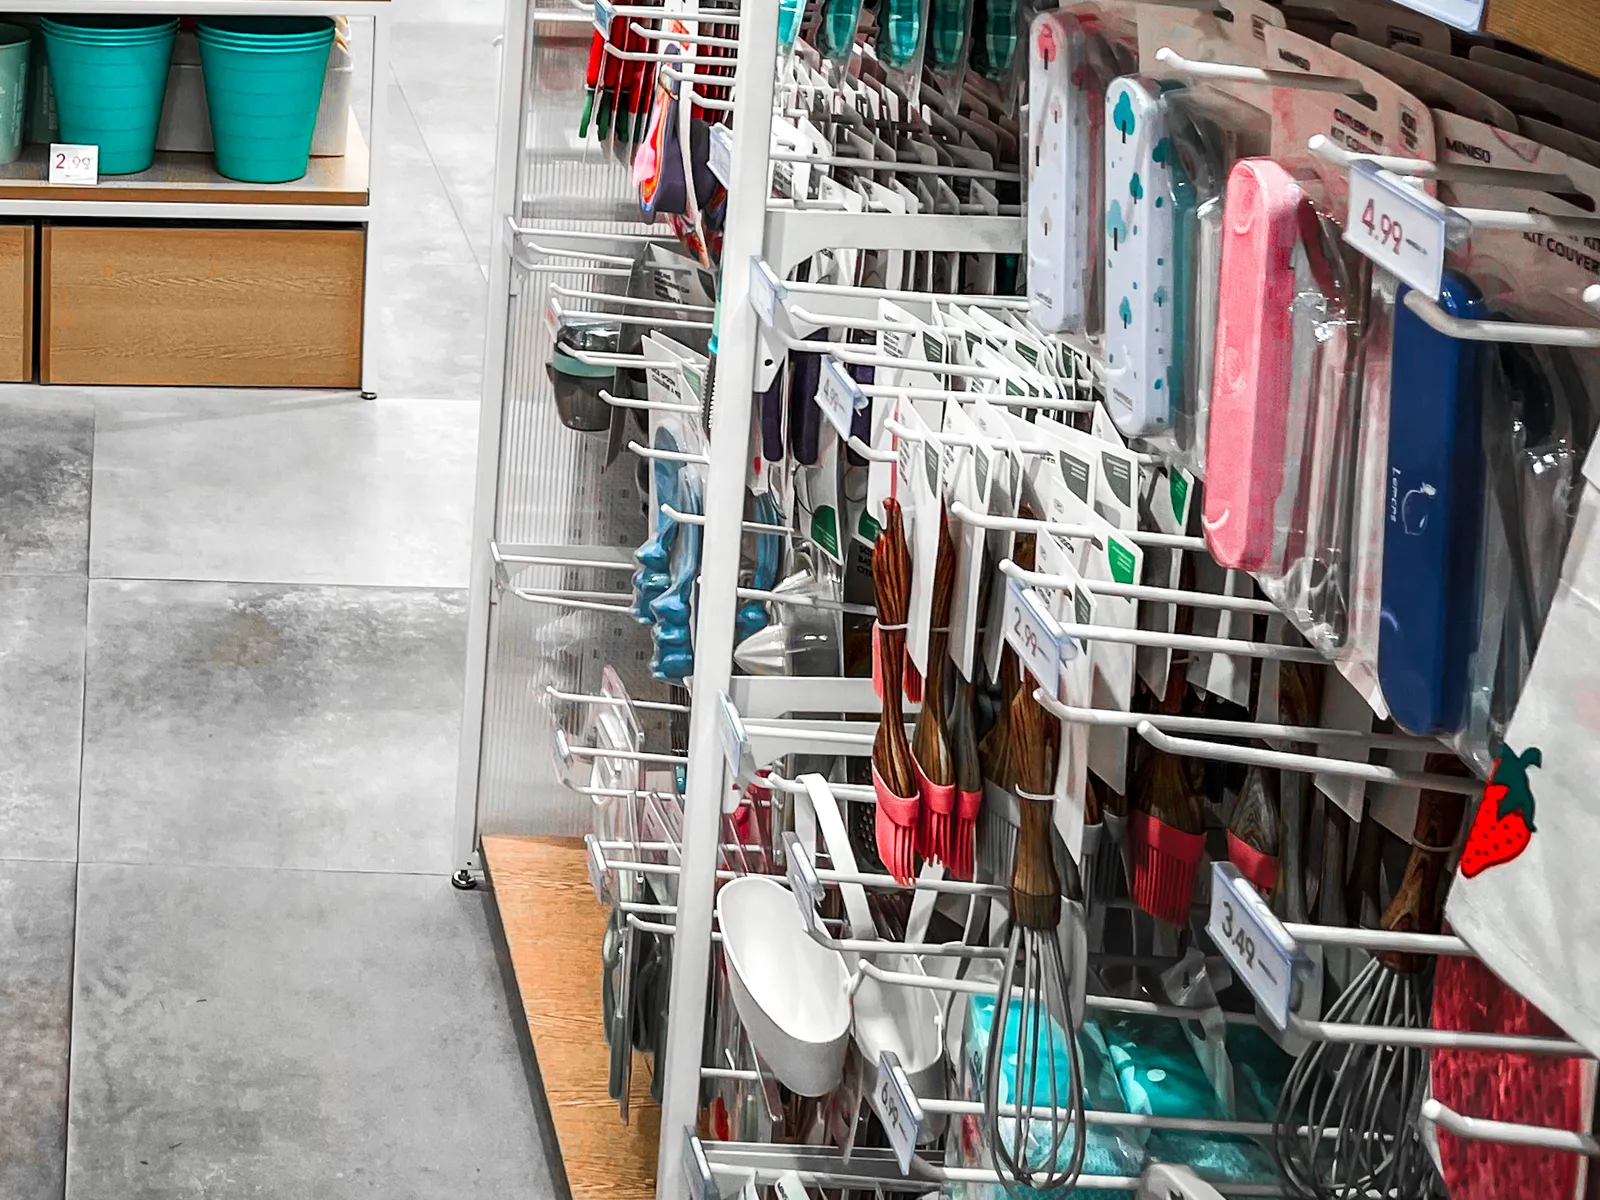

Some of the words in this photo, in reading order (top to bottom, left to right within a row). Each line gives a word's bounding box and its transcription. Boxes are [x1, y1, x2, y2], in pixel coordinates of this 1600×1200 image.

[1445, 136, 1491, 164] MINISO
[1361, 197, 1403, 256] 4.99
[1221, 901, 1255, 970] 3.49
